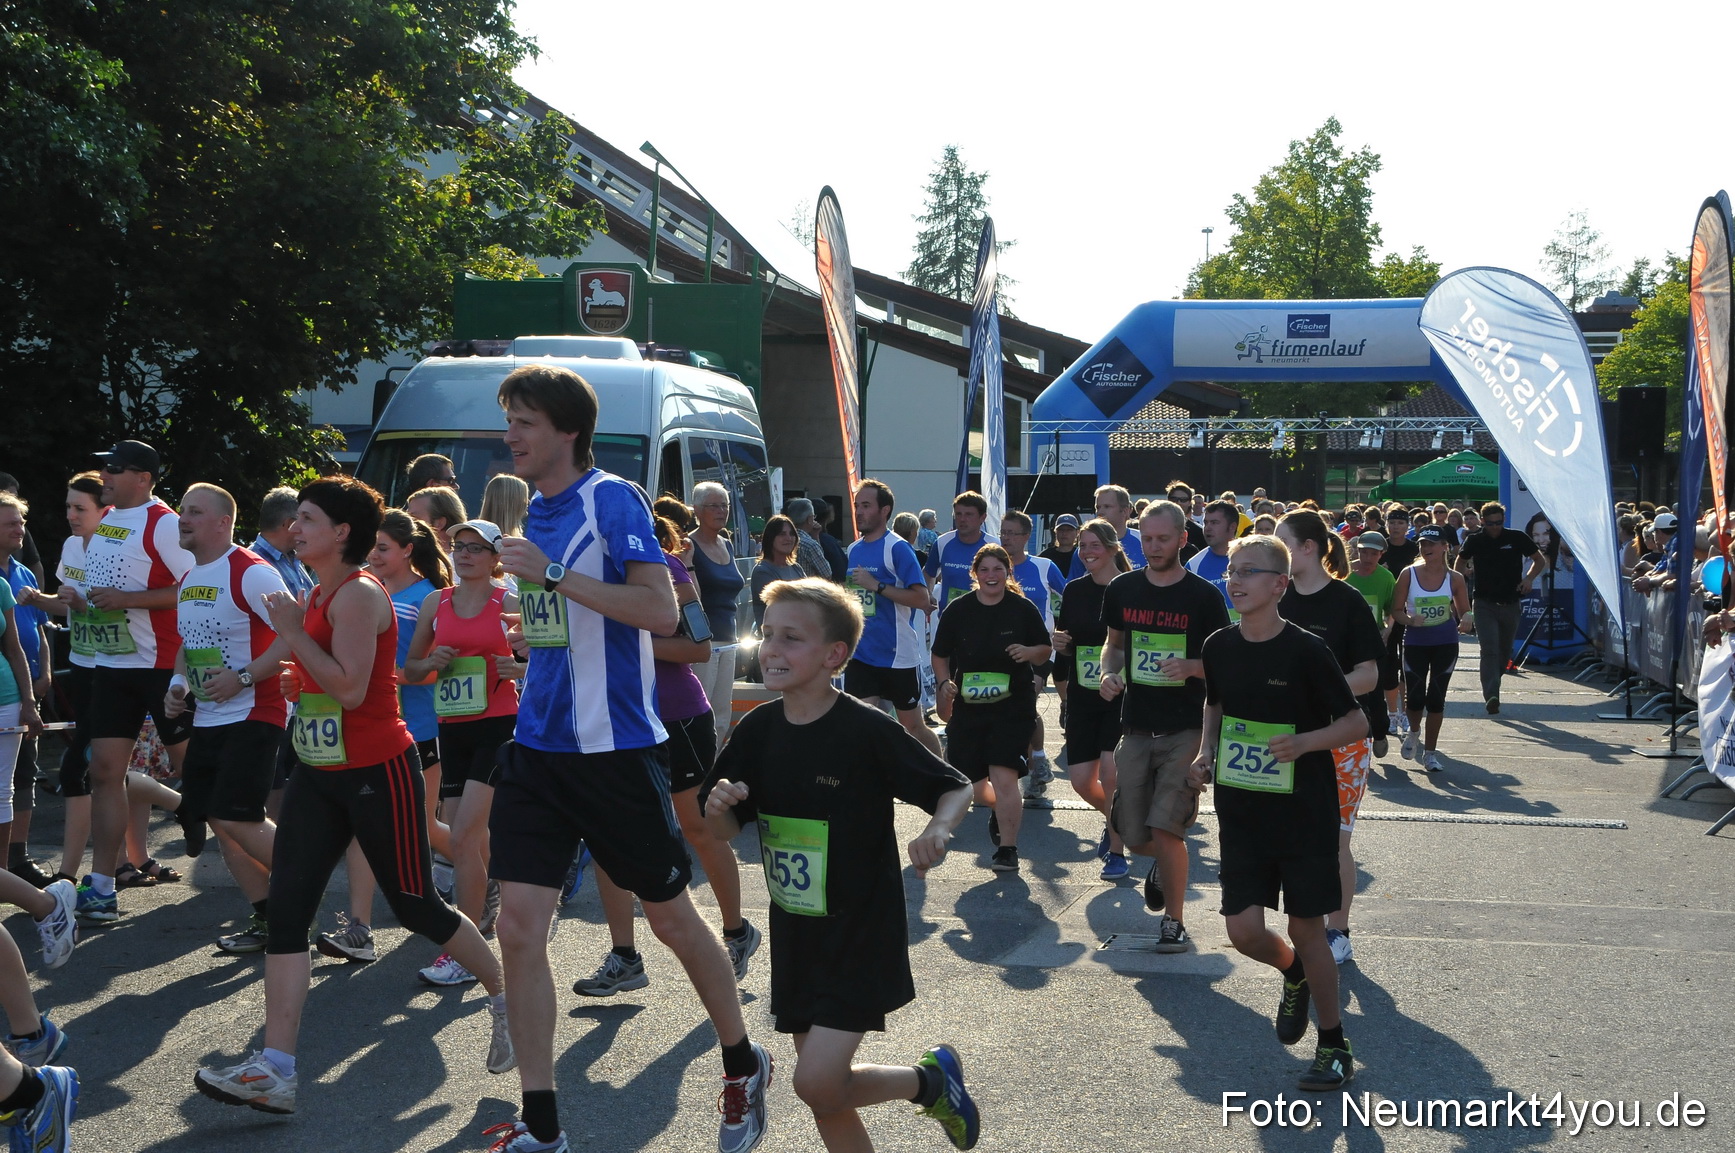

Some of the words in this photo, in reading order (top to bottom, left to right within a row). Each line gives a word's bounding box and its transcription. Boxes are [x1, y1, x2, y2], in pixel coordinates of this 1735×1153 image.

[593, 319, 618, 329] 1628
[1296, 322, 1328, 331] Fischer
[1271, 338, 1367, 357] firmenlauf
[1091, 371, 1142, 382] Fischer
[96, 525, 126, 538] ONLINE
[1420, 529, 1440, 537] adidas
[104, 537, 124, 547] Germany
[180, 587, 213, 601] ONLINE
[856, 589, 874, 606] 55
[193, 600, 216, 609] Germany
[519, 592, 561, 626] 1041
[1122, 607, 1155, 626] MANU
[1420, 605, 1445, 619] 596
[1156, 610, 1189, 630] CHAO
[89, 624, 120, 644] 917
[439, 676, 474, 702] 501
[1267, 678, 1288, 687] Julian
[1226, 742, 1281, 775] 252
[815, 776, 841, 788] Philip
[764, 845, 811, 891] 253
